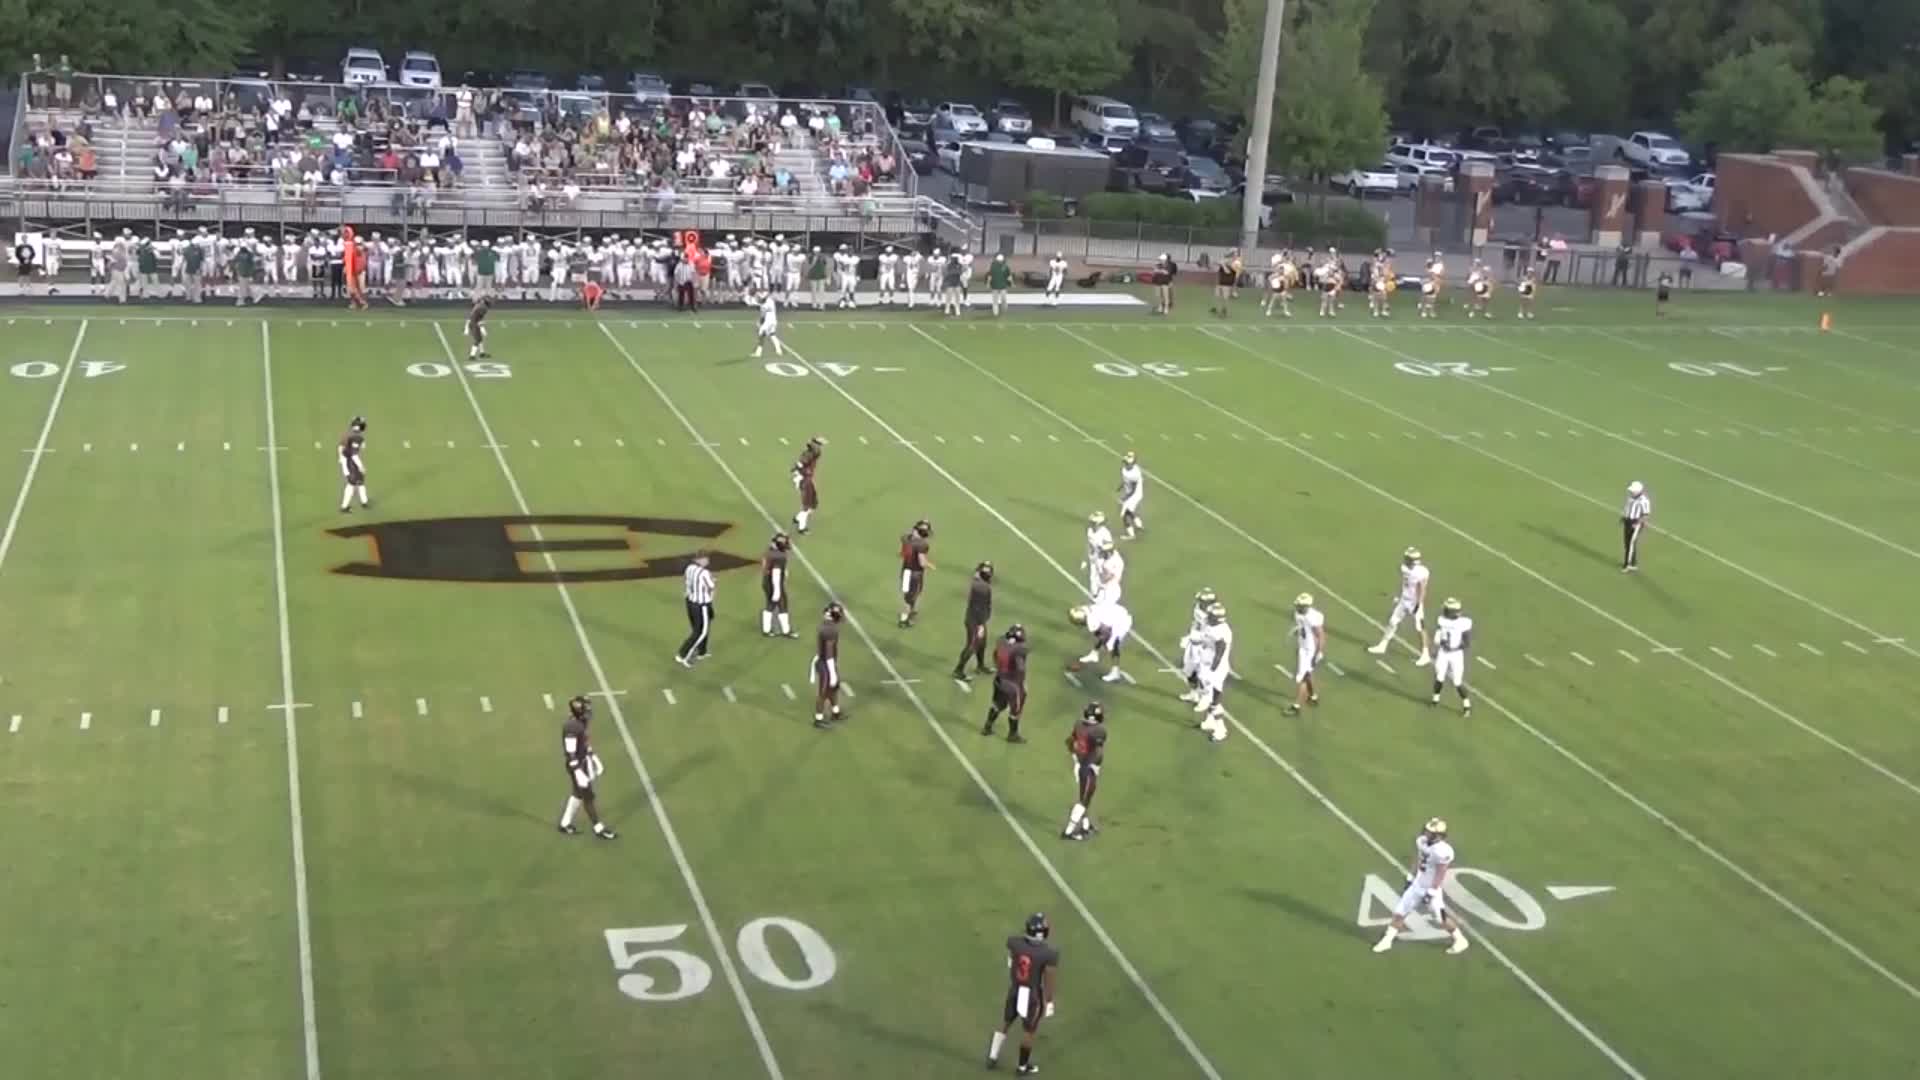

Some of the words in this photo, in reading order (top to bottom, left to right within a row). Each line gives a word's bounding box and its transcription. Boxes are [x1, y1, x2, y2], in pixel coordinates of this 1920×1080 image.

[9, 360, 128, 378] 40
[406, 362, 512, 378] 50
[764, 362, 859, 377] 40
[1093, 361, 1189, 377] 30
[603, 916, 837, 1001] 50
[1016, 954, 1031, 982] 3
